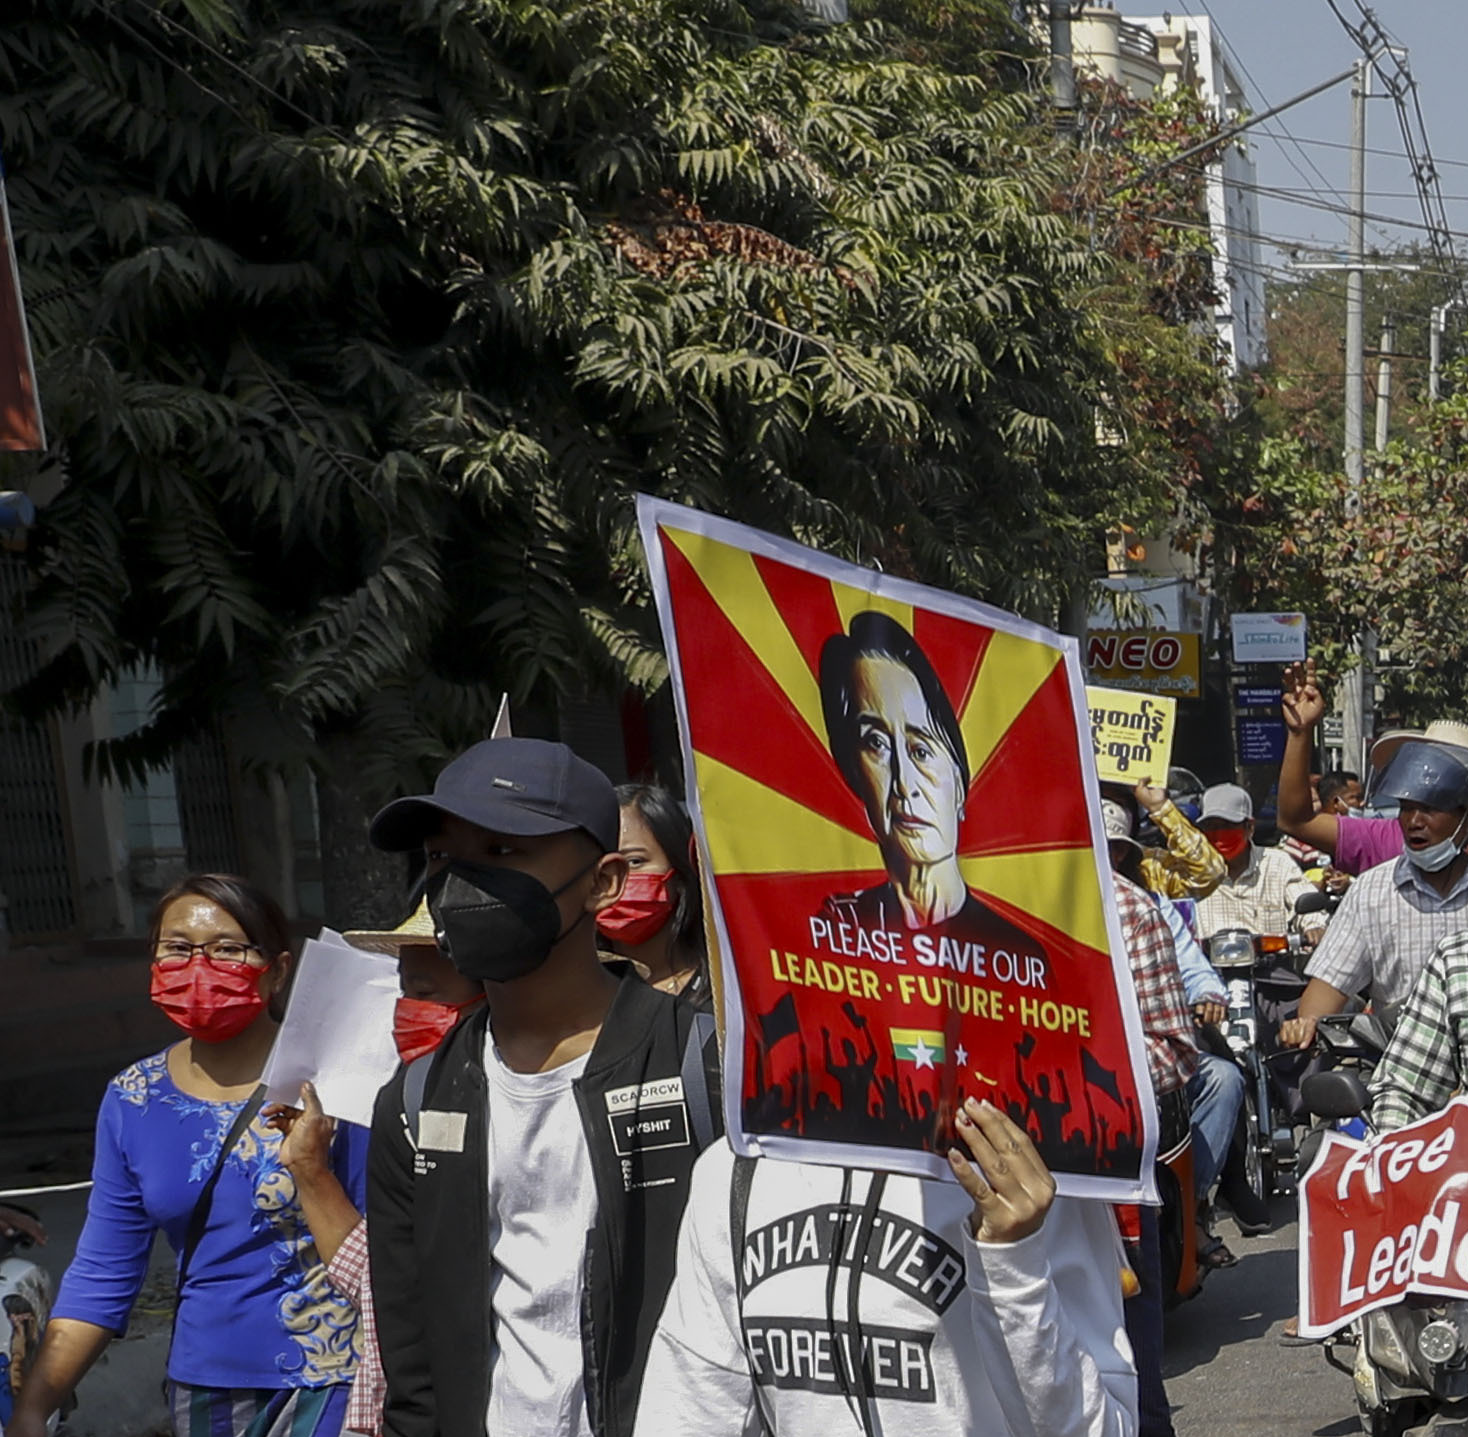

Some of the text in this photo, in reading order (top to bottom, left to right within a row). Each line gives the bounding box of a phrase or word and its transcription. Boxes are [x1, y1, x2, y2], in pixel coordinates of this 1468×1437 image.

[1088, 635, 1182, 671] NEO
[808, 916, 1046, 990] PLEASE SAVE OUR
[769, 949, 1092, 1038] LEADER FUTURE HOPE
[1337, 1126, 1455, 1200] Free
[747, 1328, 929, 1391] FOREVER
